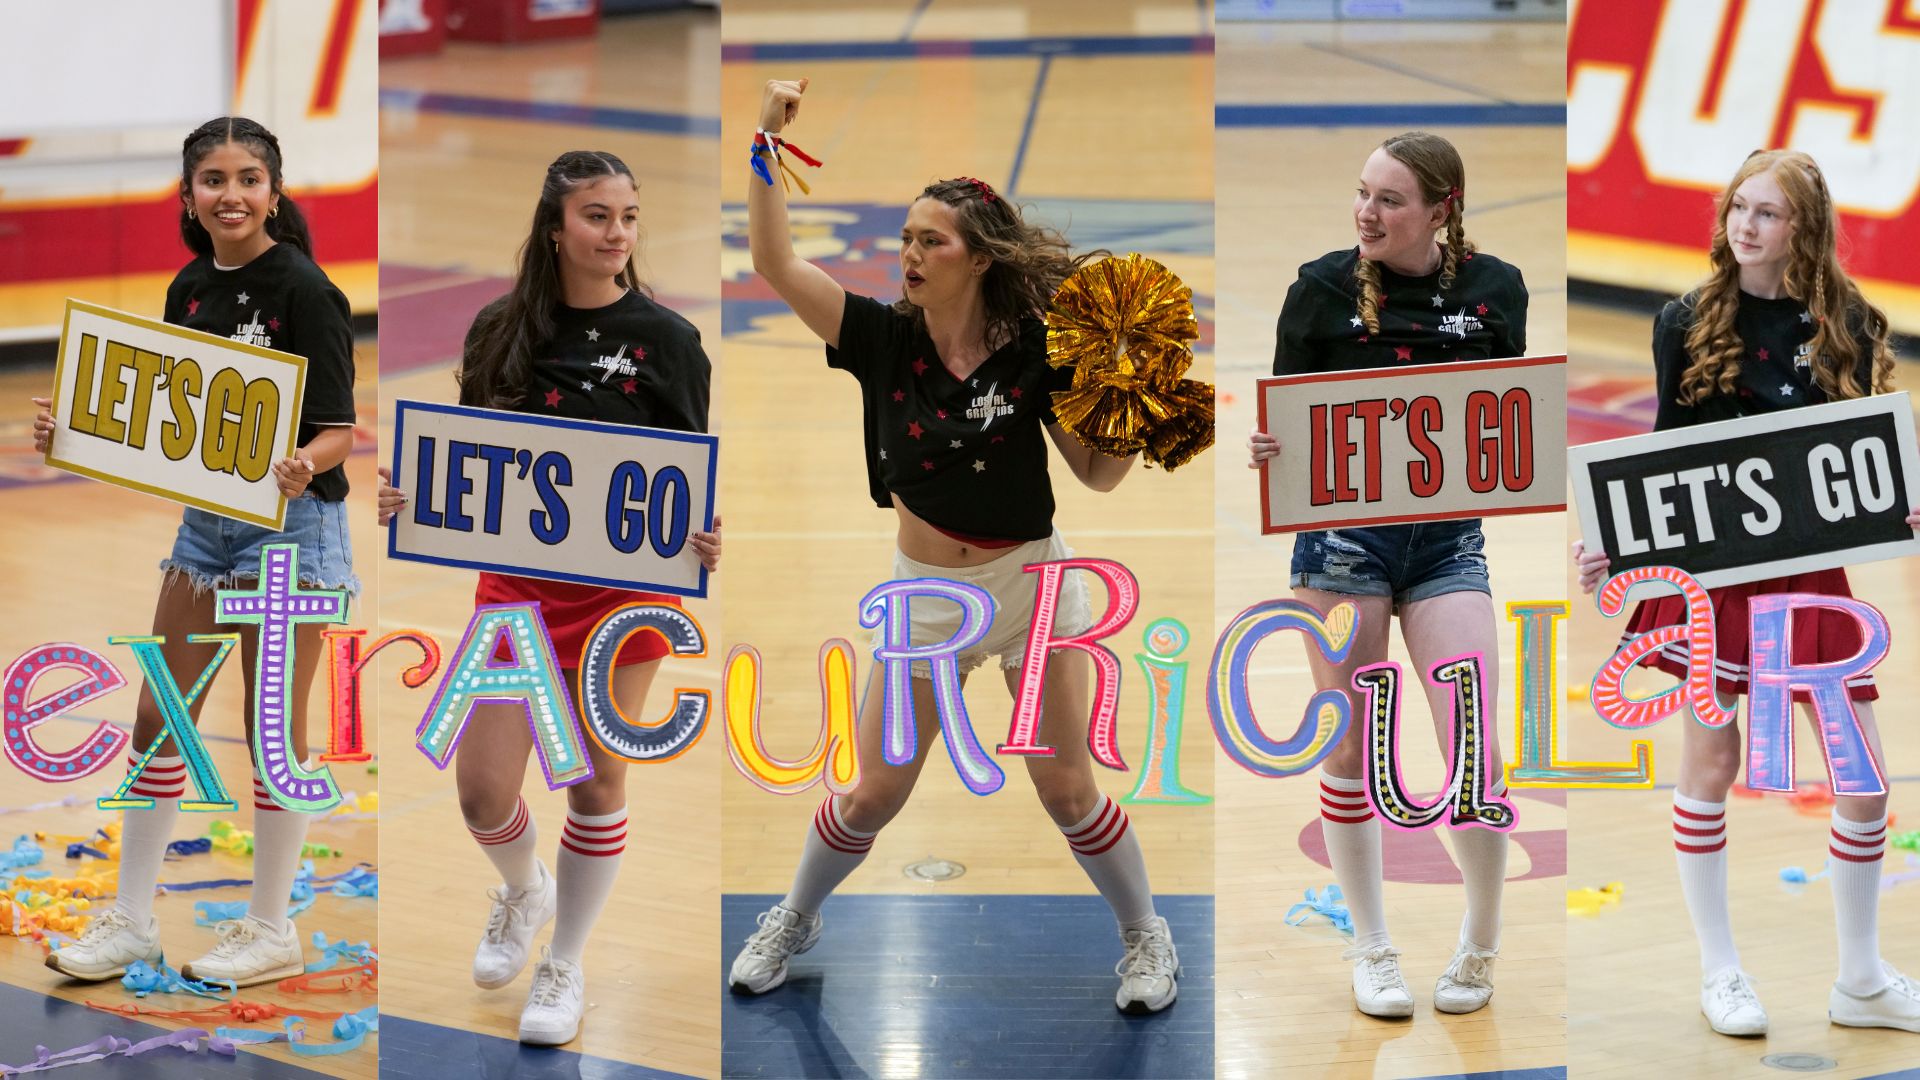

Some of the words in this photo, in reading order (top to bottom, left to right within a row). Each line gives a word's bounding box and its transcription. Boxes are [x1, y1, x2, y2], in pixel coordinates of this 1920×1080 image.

[69, 333, 202, 461] LET'S
[201, 367, 280, 483] GO
[993, 394, 1007, 405] AL
[1310, 395, 1444, 506] LET'S
[1465, 387, 1534, 493] GO
[414, 435, 573, 545] LET'S
[606, 460, 691, 559] GO
[1607, 457, 1782, 557] LET'S
[1807, 436, 1896, 523] GO
